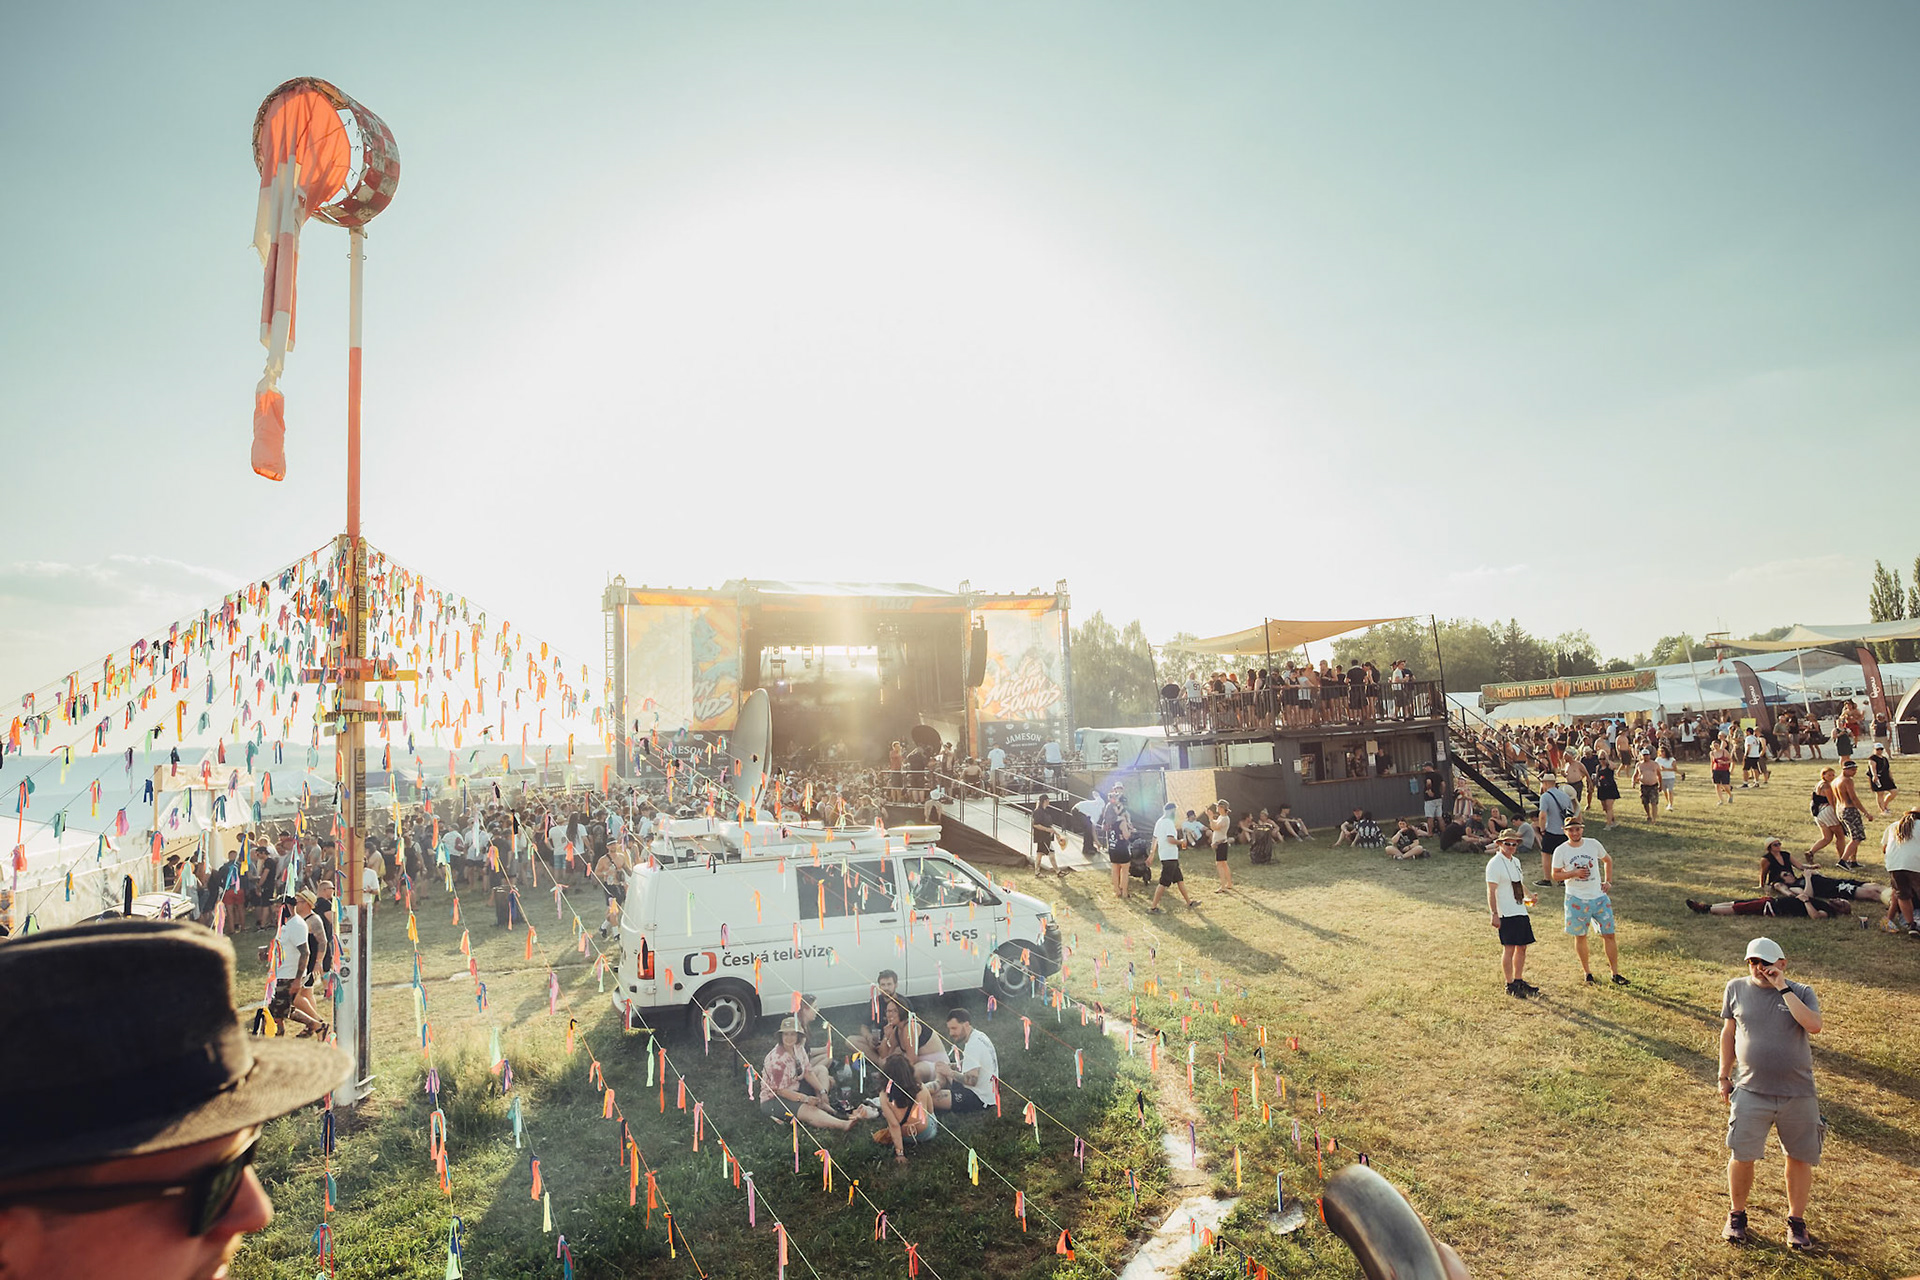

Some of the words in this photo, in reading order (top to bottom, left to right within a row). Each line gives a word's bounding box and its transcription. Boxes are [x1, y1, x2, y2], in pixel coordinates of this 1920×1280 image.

[982, 675, 1048, 709] MIGHTY
[1496, 685, 1526, 698] MIGHTY
[1528, 683, 1551, 696] BEER
[1572, 678, 1607, 692] MIGHTY
[1609, 675, 1636, 690] BEER
[995, 682, 1062, 719] SOUNDS
[1005, 732, 1042, 745] JAMESON
[933, 928, 979, 947] pess
